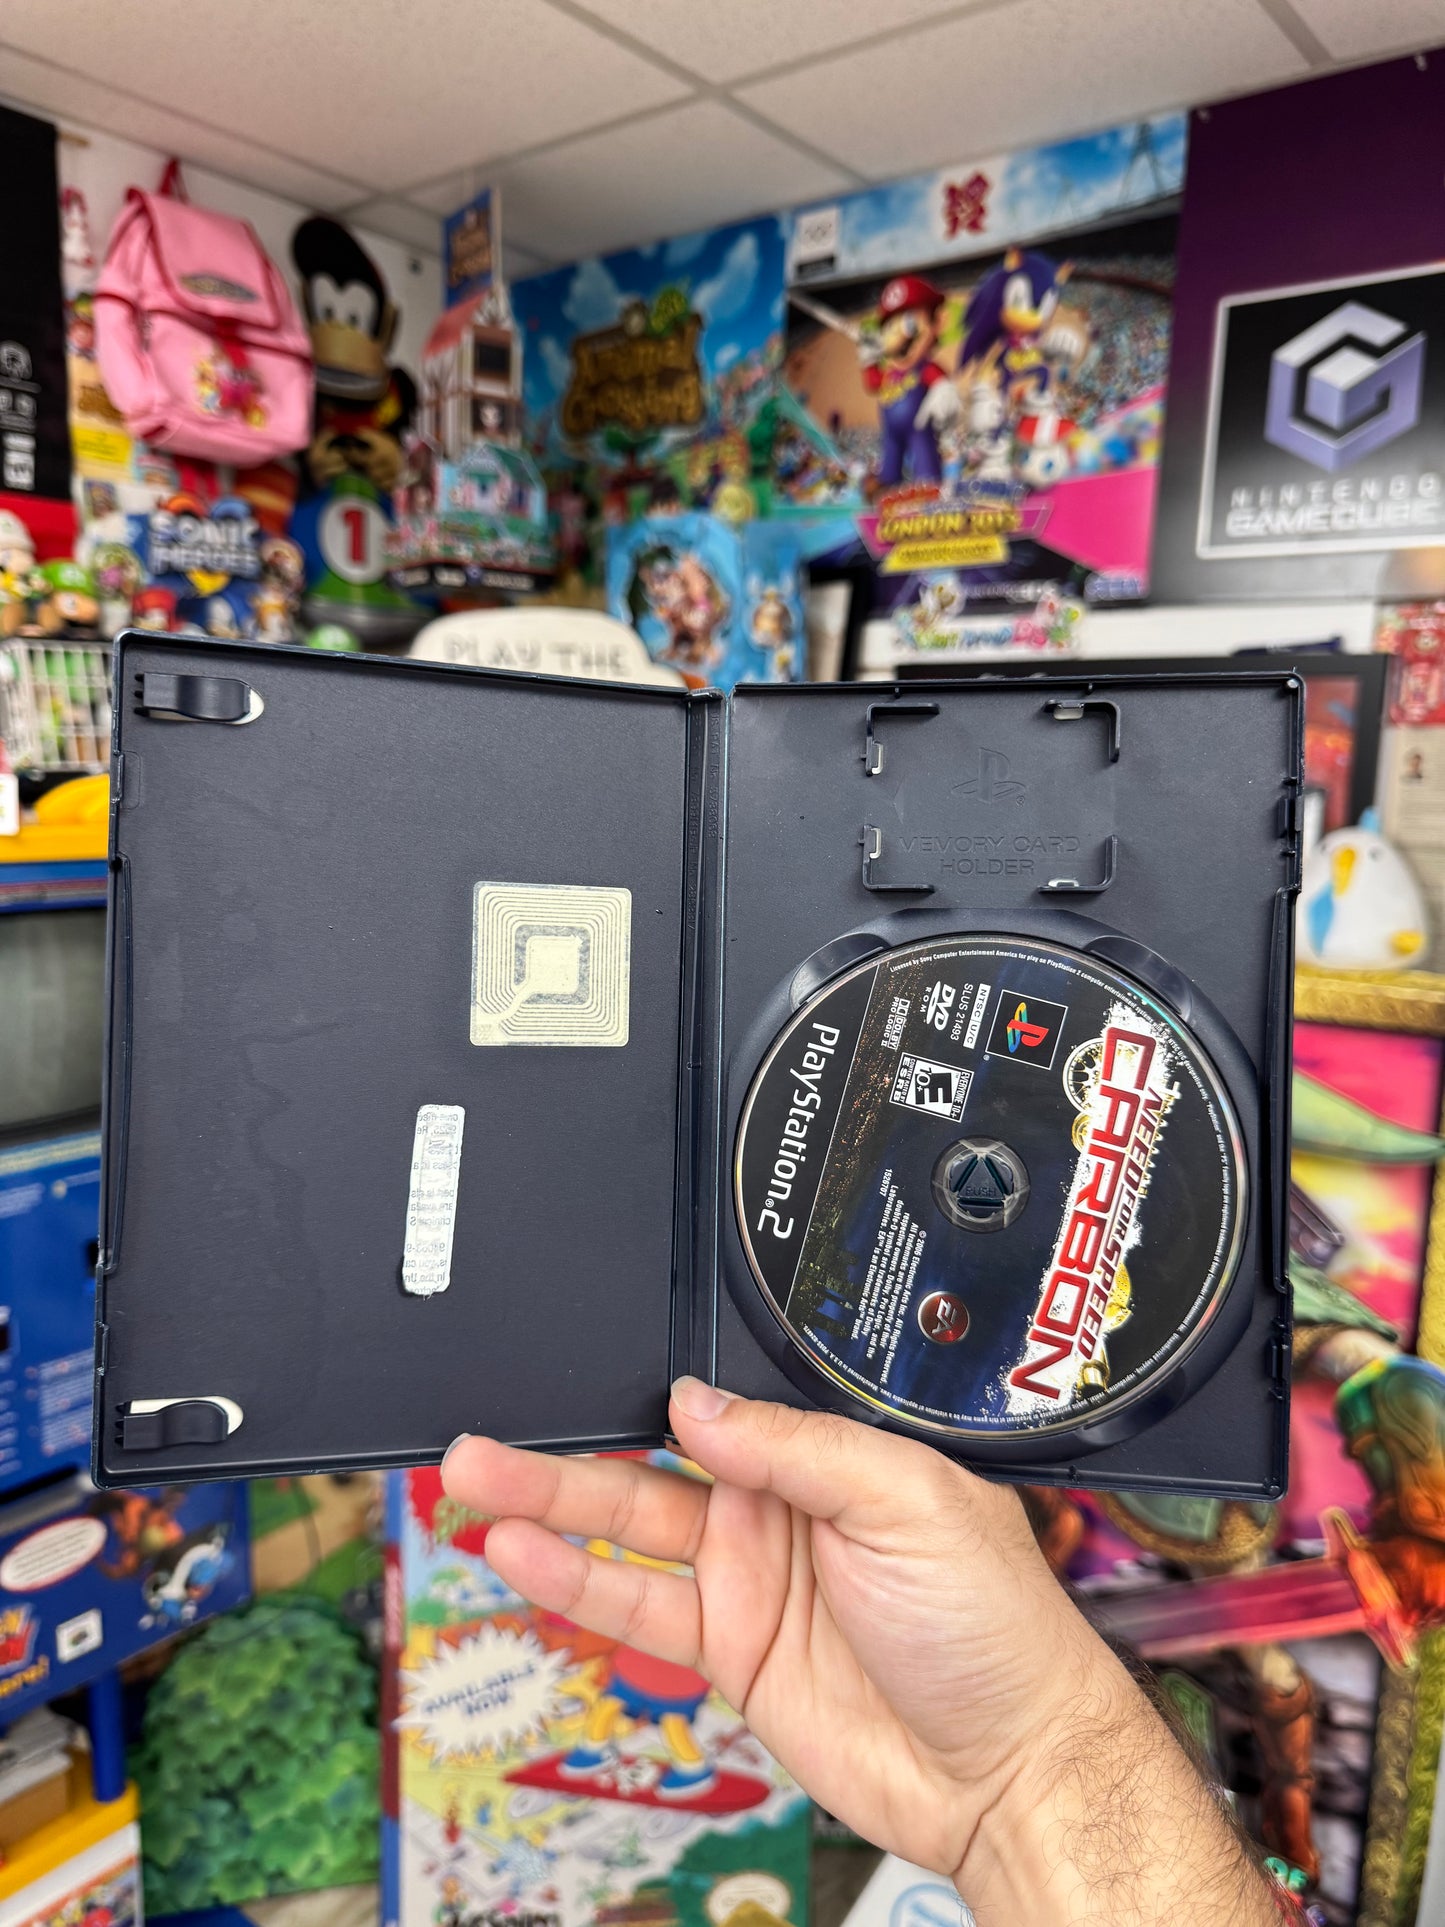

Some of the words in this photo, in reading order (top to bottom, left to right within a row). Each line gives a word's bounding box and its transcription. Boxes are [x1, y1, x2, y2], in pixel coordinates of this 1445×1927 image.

[1230, 472, 1441, 508] NINTENDO
[443, 634, 543, 669] PLAY
[552, 641, 632, 676] THE
[1013, 836, 1080, 852] CARD
[940, 858, 1035, 875] HOLDER
[919, 955, 932, 963] Sony
[933, 950, 957, 960] Computer
[958, 949, 994, 957] Entertainment
[1026, 954, 1038, 962] play
[1046, 959, 1076, 974] PlayStation
[1080, 972, 1104, 987] computer
[889, 996, 899, 1013] PRO
[919, 986, 931, 1012] ROM
[958, 982, 973, 1011] SLUS
[973, 988, 987, 1018] NTSC
[1103, 983, 1136, 1008] entertainment
[933, 983, 955, 1030] DVD
[1134, 1006, 1153, 1024] systems
[882, 1014, 894, 1038] LOGIC
[889, 1017, 903, 1047] DOLBY
[949, 1012, 965, 1041] 21493
[966, 1023, 977, 1044] U/C
[880, 1039, 887, 1047] II
[892, 1056, 910, 1101] ESRB
[905, 1058, 915, 1079] CONTENT
[902, 1079, 910, 1092] RATED
[953, 1071, 969, 1103] EVERYONE
[899, 1094, 905, 1102] BY
[949, 1104, 960, 1118] 10+
[1122, 1087, 1162, 1191] NEED
[965, 1186, 996, 1196] PUSH
[878, 1184, 898, 1229] Laboratories.
[888, 1199, 904, 1230] double-D
[1009, 1026, 1156, 1399] CARBON
[1112, 1189, 1135, 1240] FOR
[1220, 1204, 1229, 1228] registered
[755, 1207, 795, 1241] 2
[894, 1212, 911, 1247] respective
[908, 1222, 918, 1233] All
[881, 1230, 896, 1255] symbol
[898, 1233, 915, 1270] trademarks
[912, 1238, 924, 1256] 2006
[869, 1253, 879, 1264] an
[878, 1256, 889, 1268] are
[887, 1246, 902, 1273] owners.
[1208, 1261, 1218, 1274] Sony
[860, 1263, 876, 1297] Electronic
[895, 1270, 905, 1282] are
[903, 1256, 919, 1289] Electronic
[867, 1268, 886, 1307] trademarks
[881, 1274, 894, 1296] Dolby,
[891, 1282, 902, 1294] the
[877, 1296, 888, 1309] Pro
[899, 1289, 910, 1304] Arts
[1076, 1236, 1122, 1360] SPEED
[865, 1307, 875, 1316] of
[883, 1294, 899, 1323] property
[896, 1304, 906, 1317] Inc.
[931, 1298, 957, 1333] EA
[848, 1317, 862, 1340] brand.
[859, 1315, 873, 1336] Dolby
[871, 1310, 885, 1331] Logic,
[881, 1323, 891, 1331] of
[893, 1318, 903, 1328] All
[867, 1332, 879, 1346] and
[877, 1331, 889, 1348] their
[887, 1328, 900, 1350] Rights
[864, 1346, 875, 1358] the
[878, 1350, 894, 1384] Reserved.
